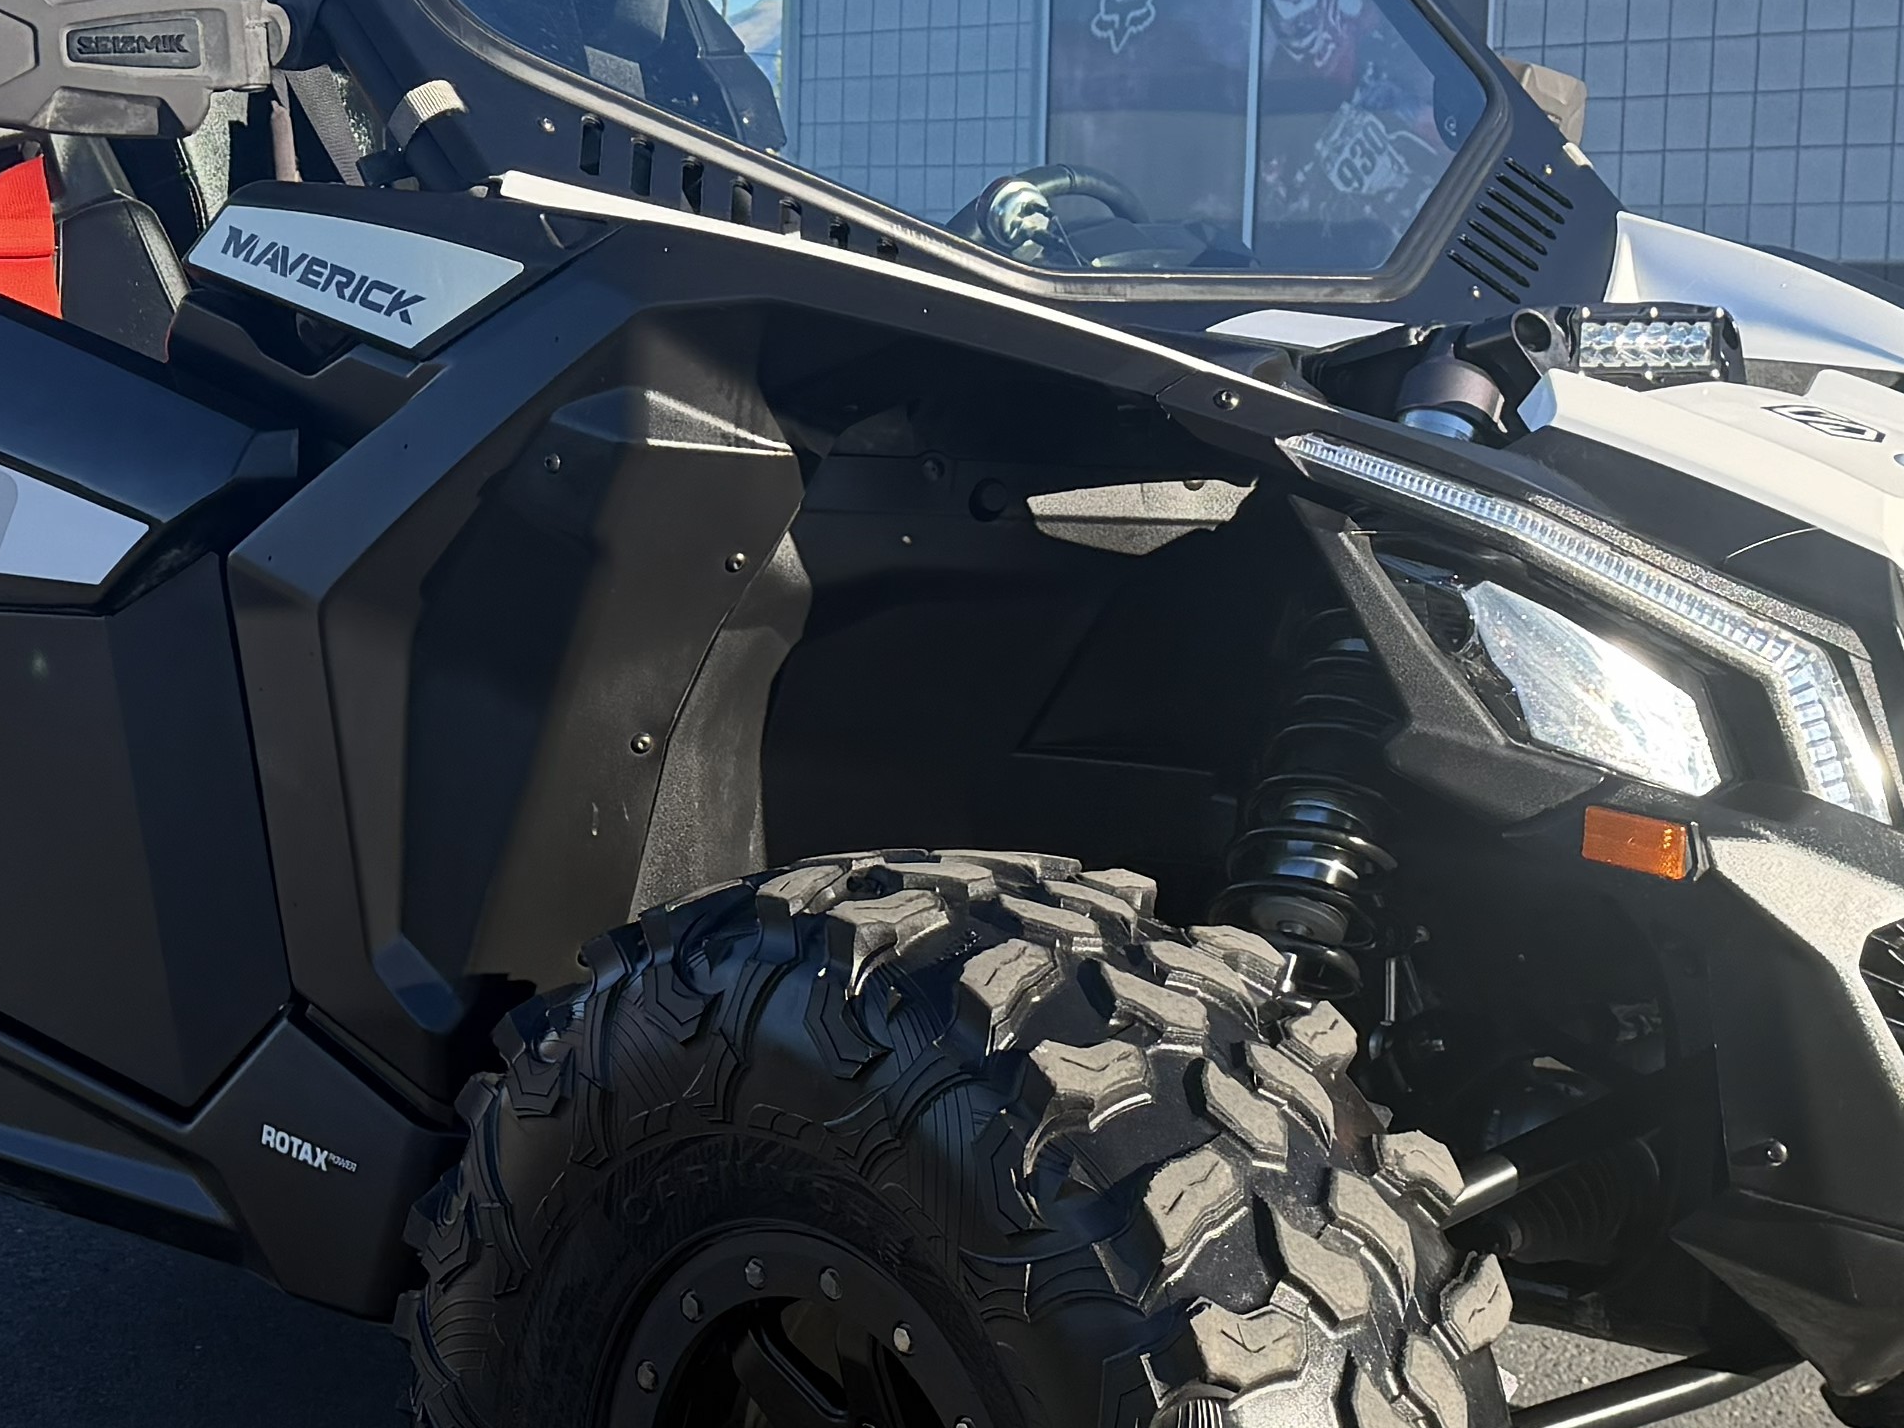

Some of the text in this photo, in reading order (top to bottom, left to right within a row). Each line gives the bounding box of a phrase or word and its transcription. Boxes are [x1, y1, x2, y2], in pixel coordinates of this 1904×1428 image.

[75, 29, 190, 57] SEIZMIK
[1336, 119, 1389, 191] 930
[218, 224, 427, 326] MAVERICK
[261, 1124, 329, 1172] ROTAX
